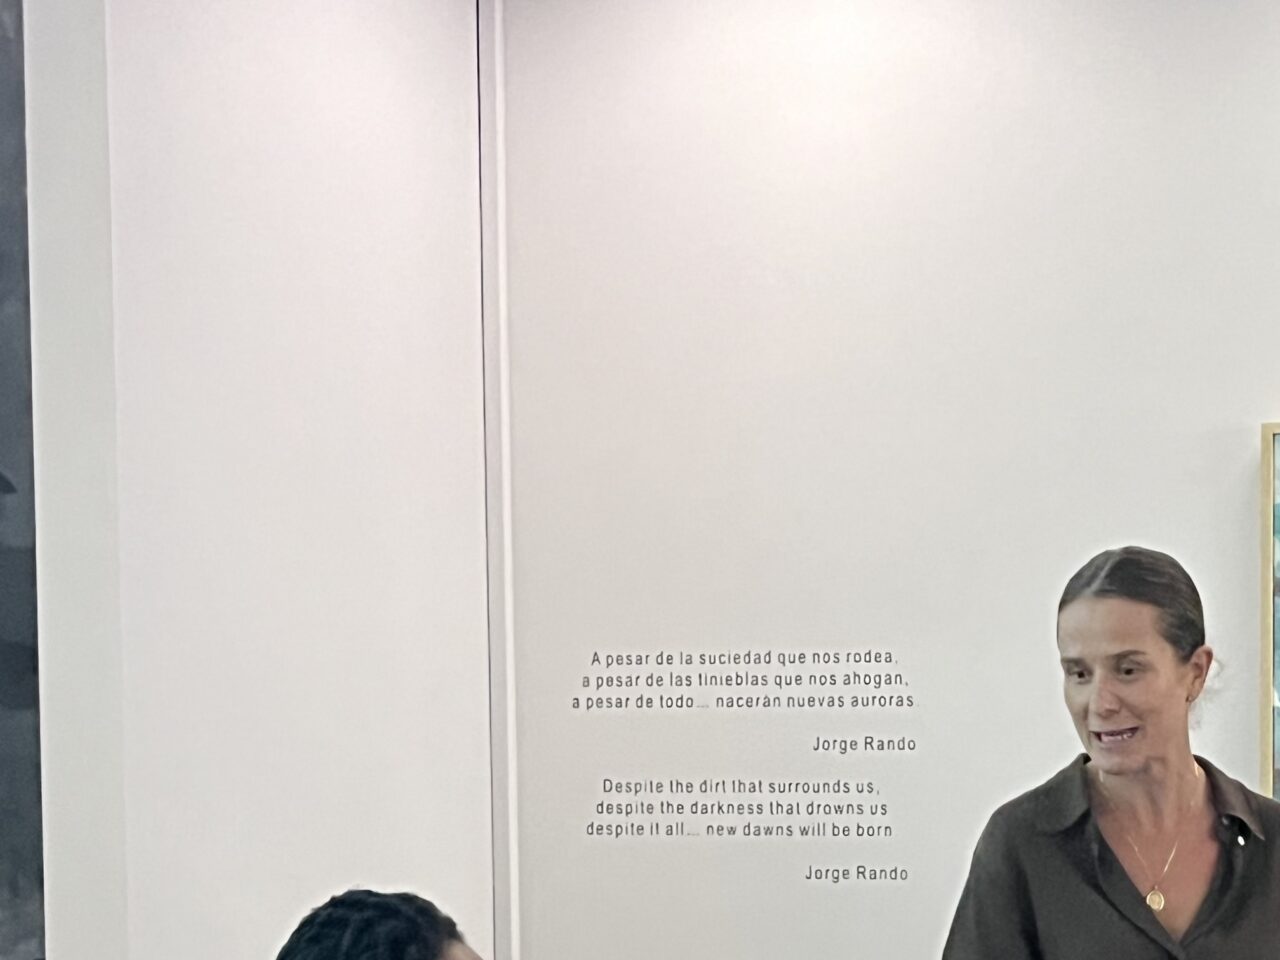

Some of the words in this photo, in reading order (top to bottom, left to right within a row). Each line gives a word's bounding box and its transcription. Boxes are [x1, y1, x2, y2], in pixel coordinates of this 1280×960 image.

[590, 650, 602, 667] A
[605, 653, 651, 670] pesar
[655, 650, 674, 666] de
[679, 650, 694, 666] la
[698, 649, 772, 666] suciedad
[777, 652, 807, 668] que
[811, 651, 841, 665] nos
[845, 649, 898, 665] rodea,
[581, 675, 591, 688] a
[595, 673, 641, 692] pesar
[645, 672, 664, 688] de
[669, 671, 693, 688] las
[697, 670, 769, 687] tinieblas
[773, 674, 803, 690] que
[808, 673, 837, 687] nos
[842, 670, 909, 690] ahogan,
[571, 697, 581, 710] a
[585, 696, 631, 712] pesar
[635, 693, 654, 709] de
[715, 694, 782, 709] nacerán
[786, 695, 845, 709] nuevas
[812, 736, 859, 755] Jorge
[863, 735, 917, 752] Rando
[602, 778, 664, 797] Despite
[669, 778, 694, 794] the
[698, 778, 727, 794] dirt
[731, 778, 764, 794] that
[768, 778, 851, 795] surrounds
[855, 781, 881, 796] us,
[595, 799, 655, 818] despite
[659, 800, 685, 815] the
[690, 800, 764, 816] darkness
[769, 799, 801, 816] that
[805, 800, 865, 816] drowns
[869, 803, 888, 816] us
[586, 821, 645, 839] despite
[649, 821, 660, 837] it
[705, 824, 737, 837] new
[742, 821, 794, 837] dawns
[798, 821, 827, 837] will
[831, 821, 851, 837] be
[855, 822, 893, 838] born
[804, 864, 851, 884] Jorge
[856, 864, 909, 881] Rando
